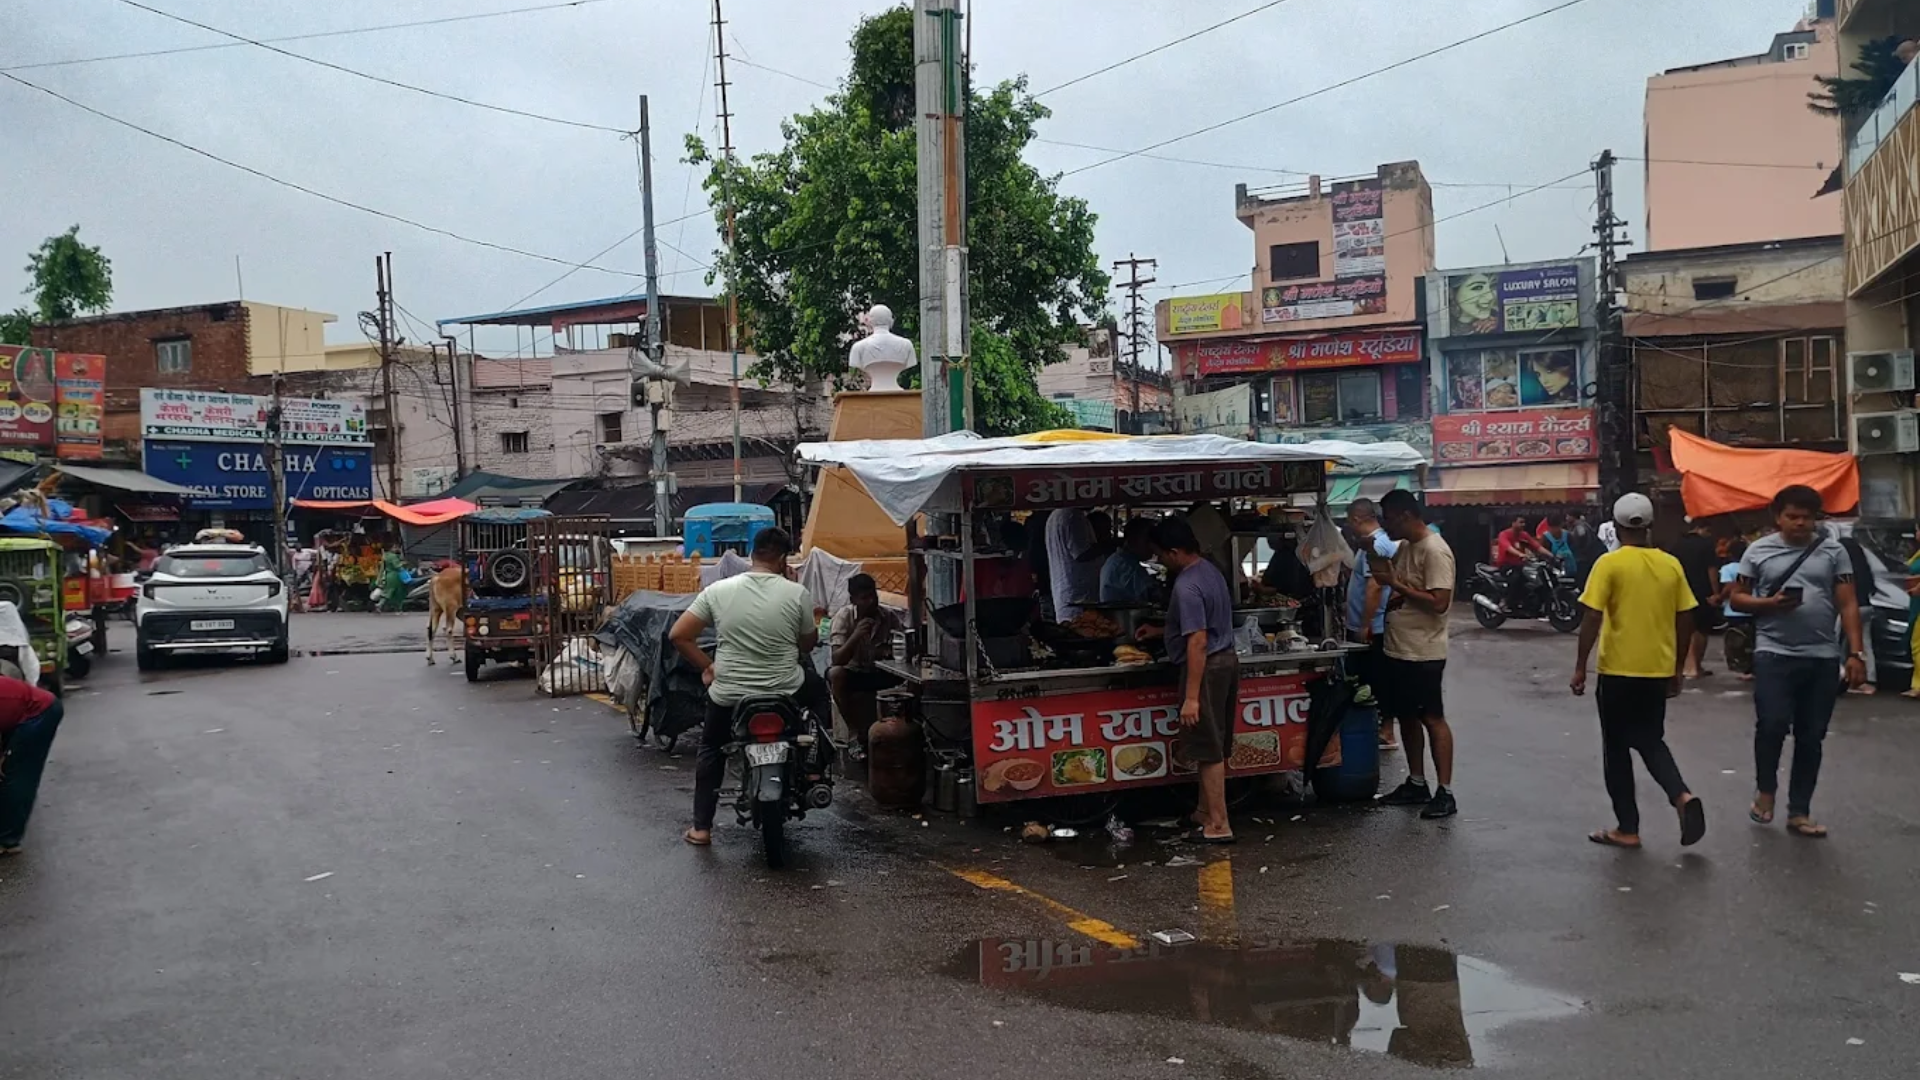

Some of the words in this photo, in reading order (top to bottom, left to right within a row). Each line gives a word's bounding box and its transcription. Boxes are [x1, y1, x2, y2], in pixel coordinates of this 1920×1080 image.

[1503, 280, 1541, 291] LUXURY
[1543, 277, 1577, 288] SALON
[1288, 340, 1307, 359] श्री
[1310, 337, 1354, 357] गणेश
[164, 426, 211, 435] CHADHA
[213, 429, 258, 437] MEDICAL
[306, 434, 352, 442] OPTICALS
[1461, 419, 1481, 436] श्री
[1486, 421, 1533, 435] श्याम
[217, 452, 316, 473] CHAHA
[1026, 473, 1113, 501] ओम
[1119, 473, 1202, 497] खस्ता
[1213, 464, 1272, 490] वाले
[225, 485, 266, 498] STORE
[313, 486, 369, 499] OPTICALS
[990, 707, 1084, 751] ओम
